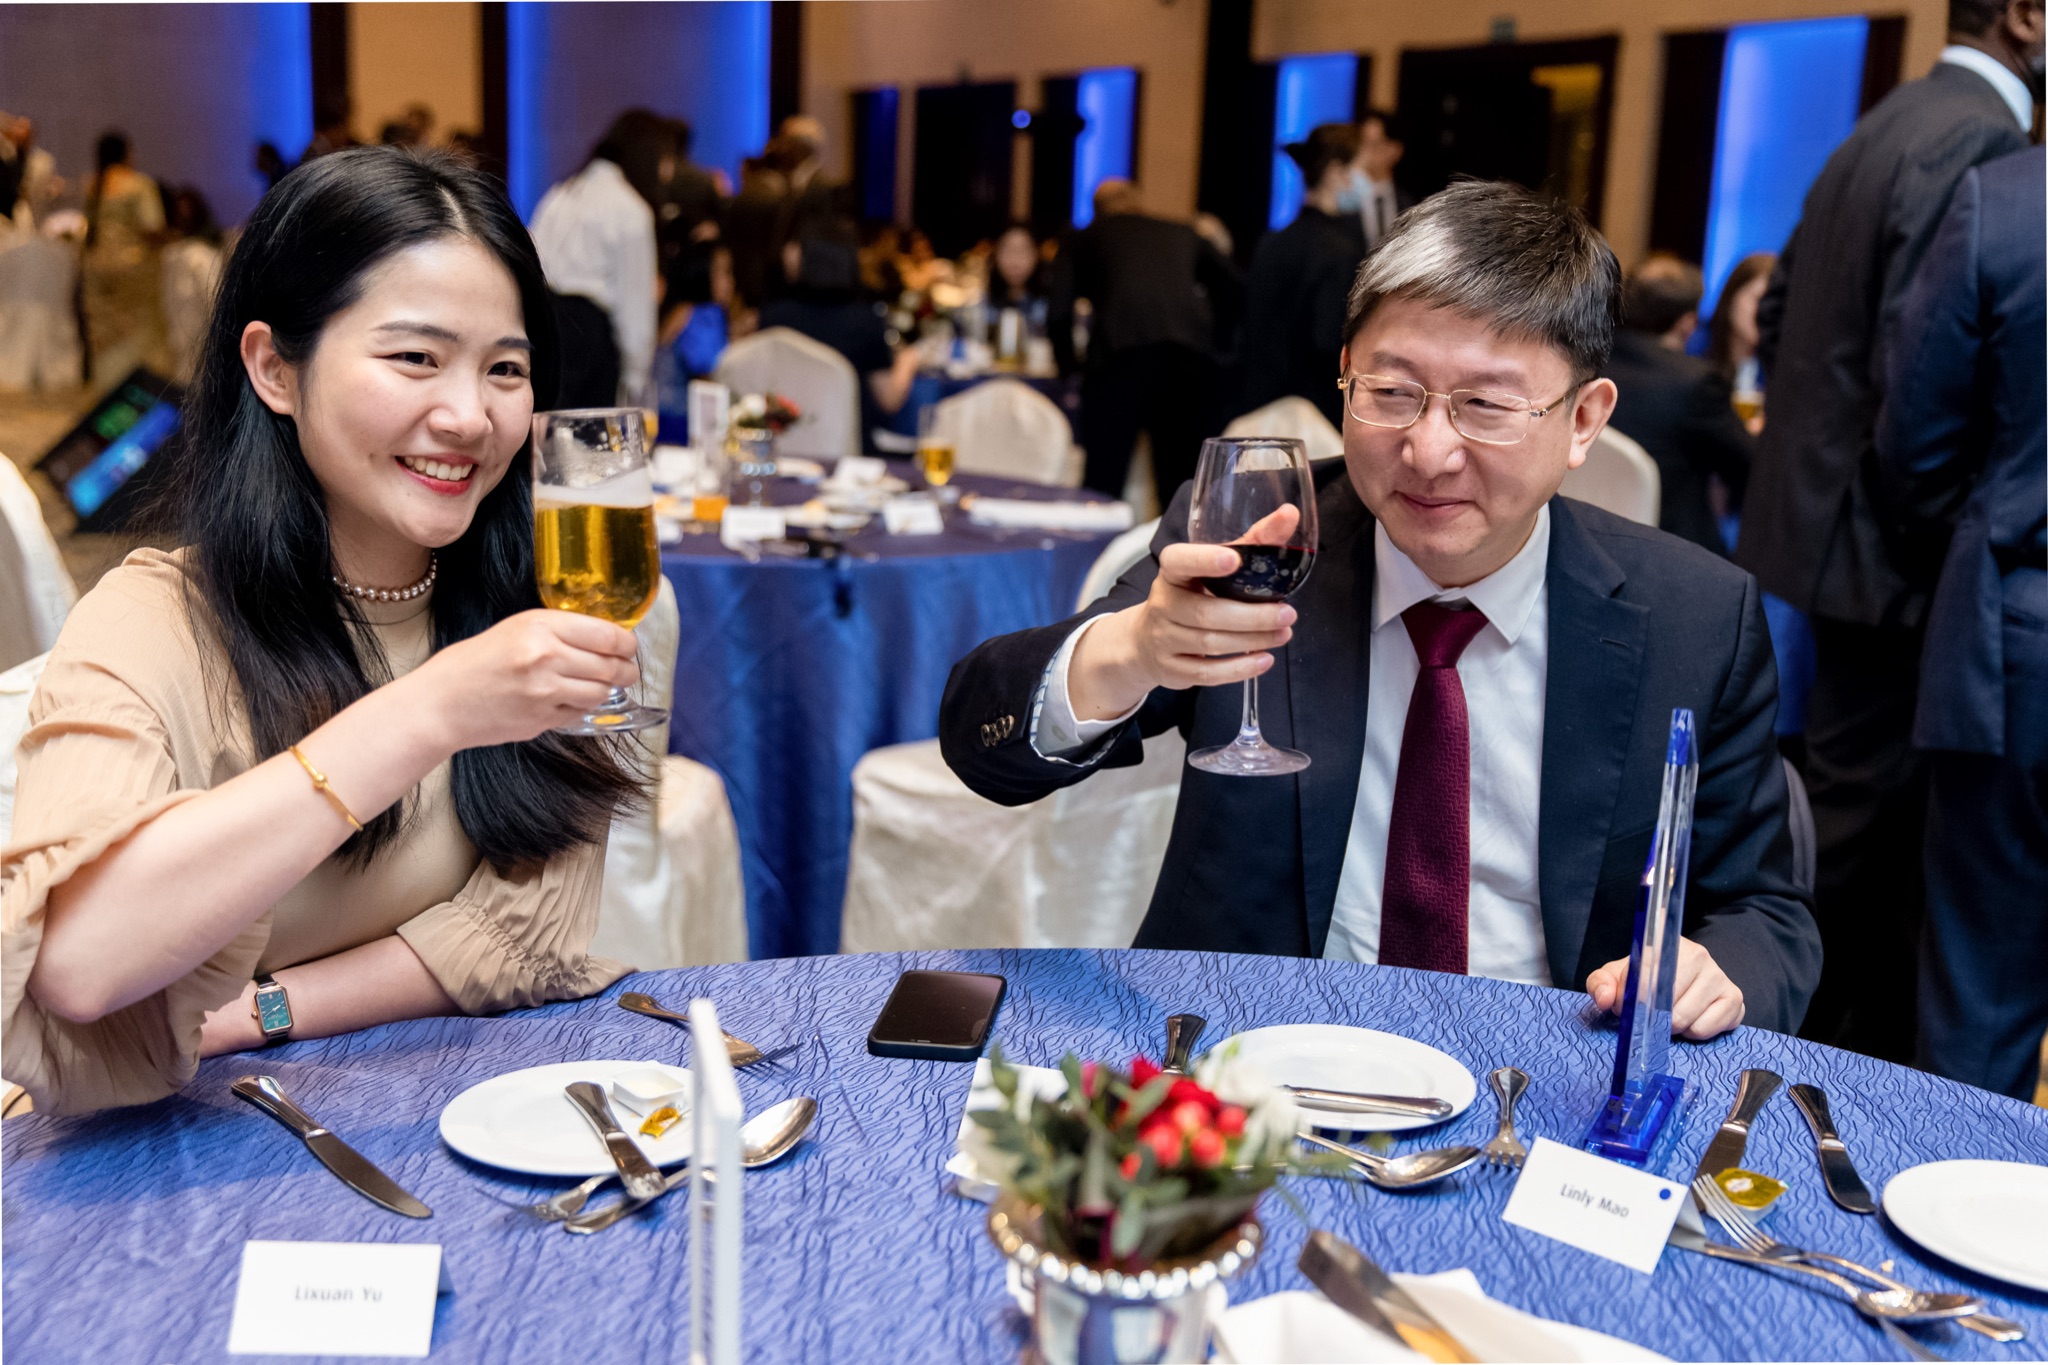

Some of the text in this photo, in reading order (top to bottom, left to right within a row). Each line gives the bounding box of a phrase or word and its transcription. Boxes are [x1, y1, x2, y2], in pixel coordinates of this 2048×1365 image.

[1560, 1183, 1630, 1218] Linly Mao
[294, 1285, 383, 1303] Lixuan Yu
